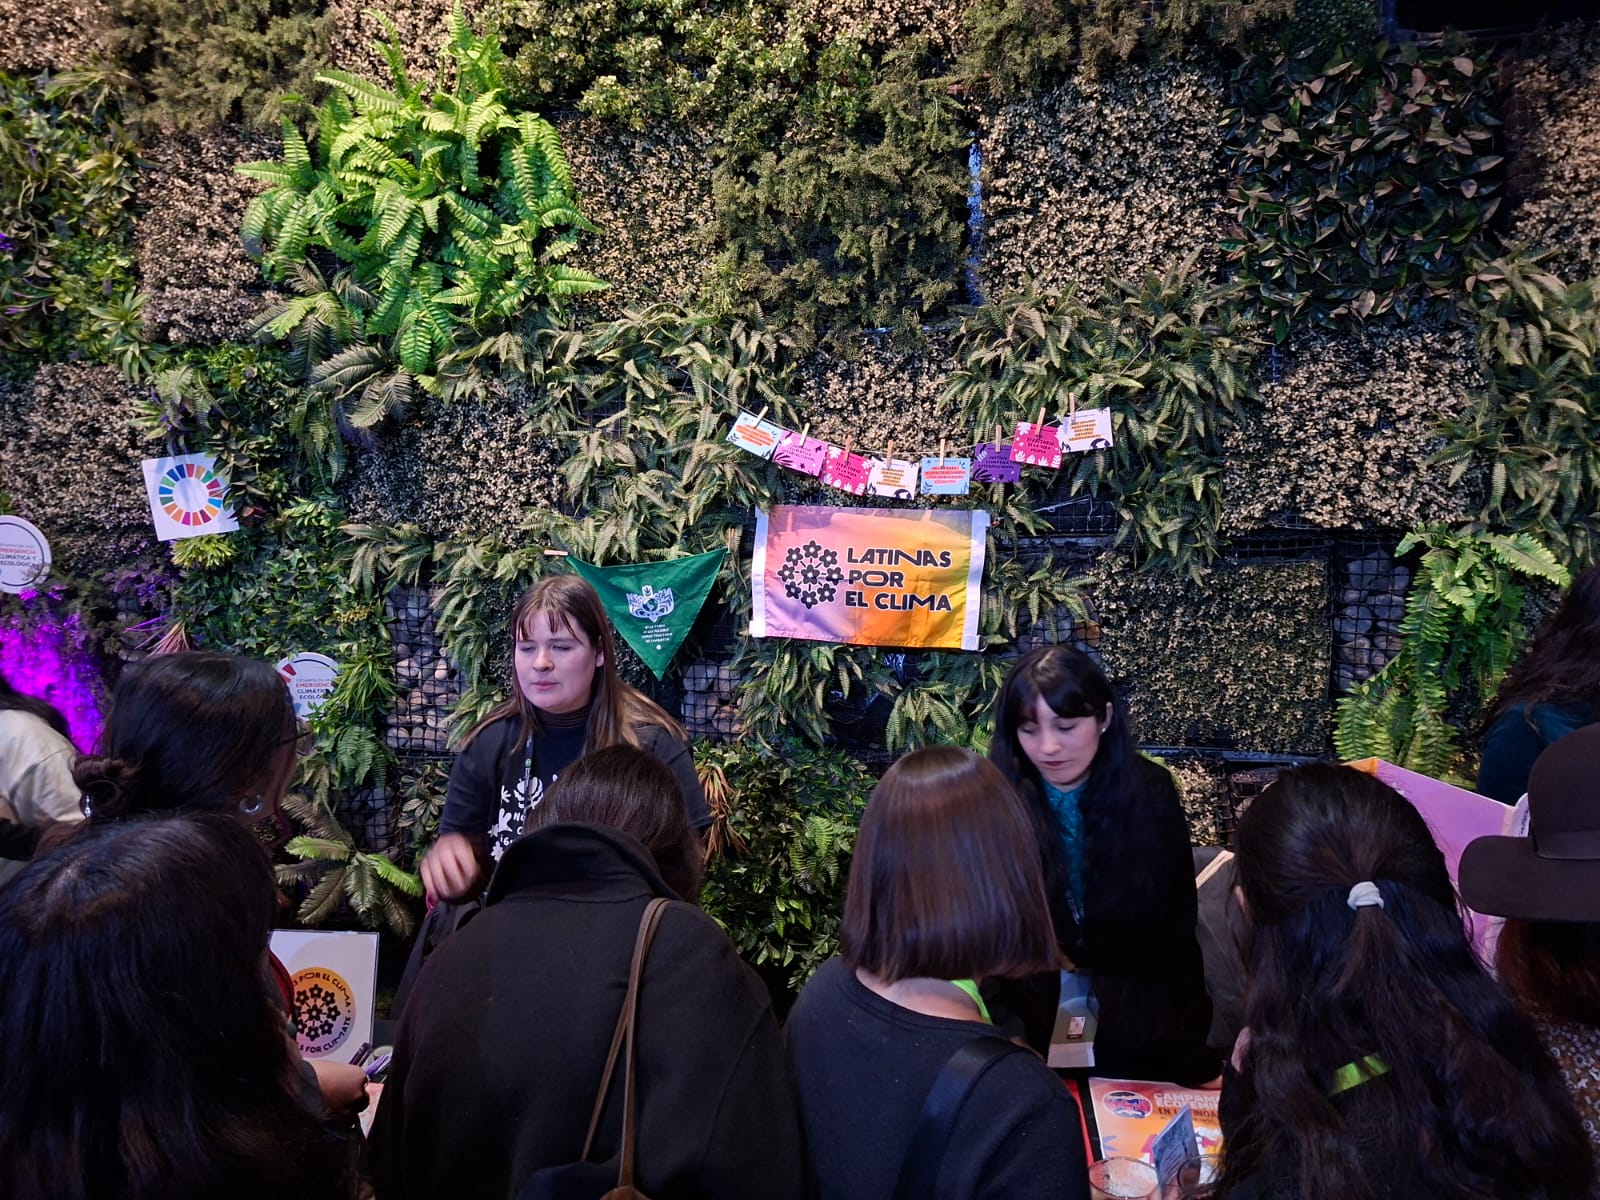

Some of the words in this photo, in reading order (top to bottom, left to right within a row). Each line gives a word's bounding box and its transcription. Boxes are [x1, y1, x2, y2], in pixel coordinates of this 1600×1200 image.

[847, 547, 952, 568] LATINAS
[848, 569, 904, 588] POR
[845, 591, 869, 608] EL
[874, 593, 952, 611] CLIMA
[299, 972, 321, 982] POR
[322, 973, 331, 982] EL
[332, 978, 351, 1007] CLIMA
[323, 1016, 351, 1051] CLIMATE
